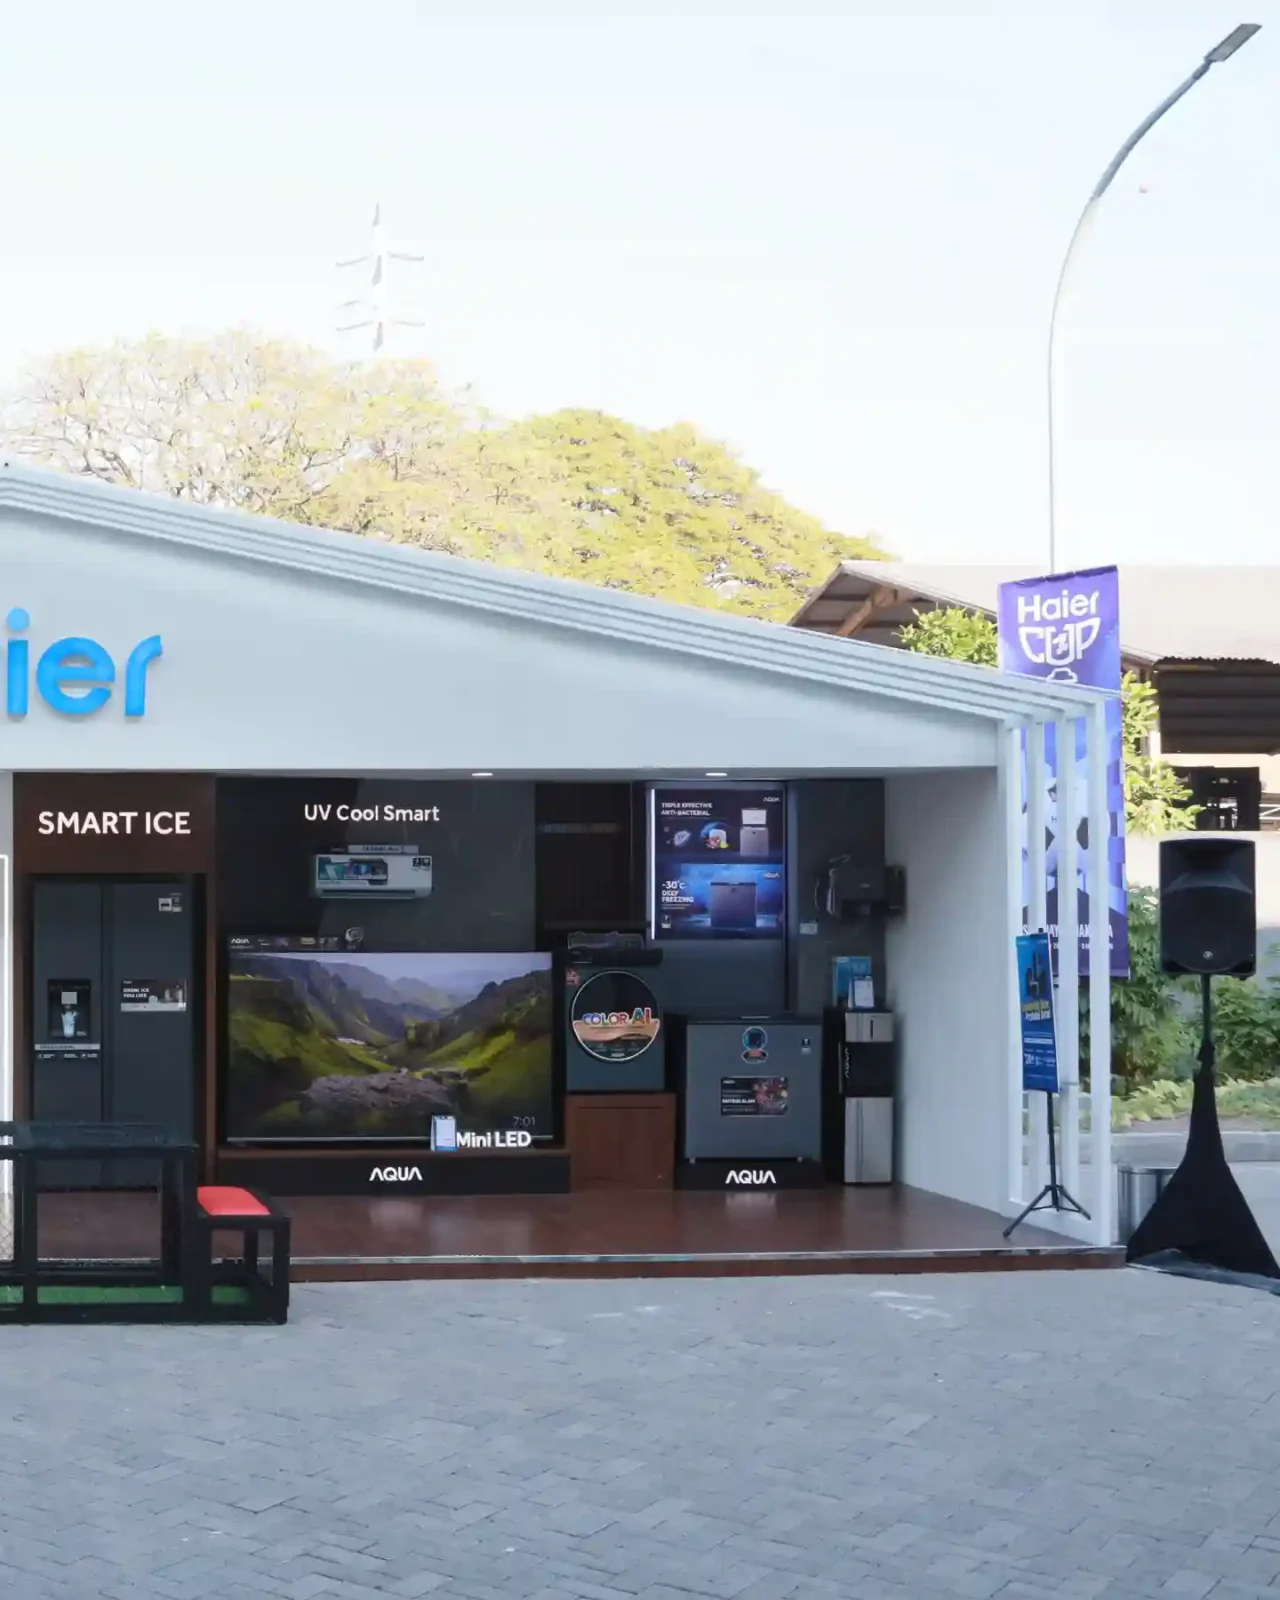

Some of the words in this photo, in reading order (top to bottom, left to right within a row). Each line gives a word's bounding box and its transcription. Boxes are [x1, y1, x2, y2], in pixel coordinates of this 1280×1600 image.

[1017, 589, 1099, 624] Haier
[1018, 617, 1101, 666] CUP
[304, 804, 332, 821] UV
[336, 804, 379, 822] Cool
[383, 804, 440, 822] Smart
[38, 811, 138, 835] SMART
[145, 811, 191, 835] ICE
[581, 1012, 629, 1026] COLOR
[631, 1007, 652, 1025] AI
[513, 1116, 536, 1127] 7:01
[456, 1132, 491, 1148] Mini
[494, 1131, 532, 1147] LED
[369, 1167, 423, 1181] AQUA
[725, 1169, 776, 1184] AQUA
